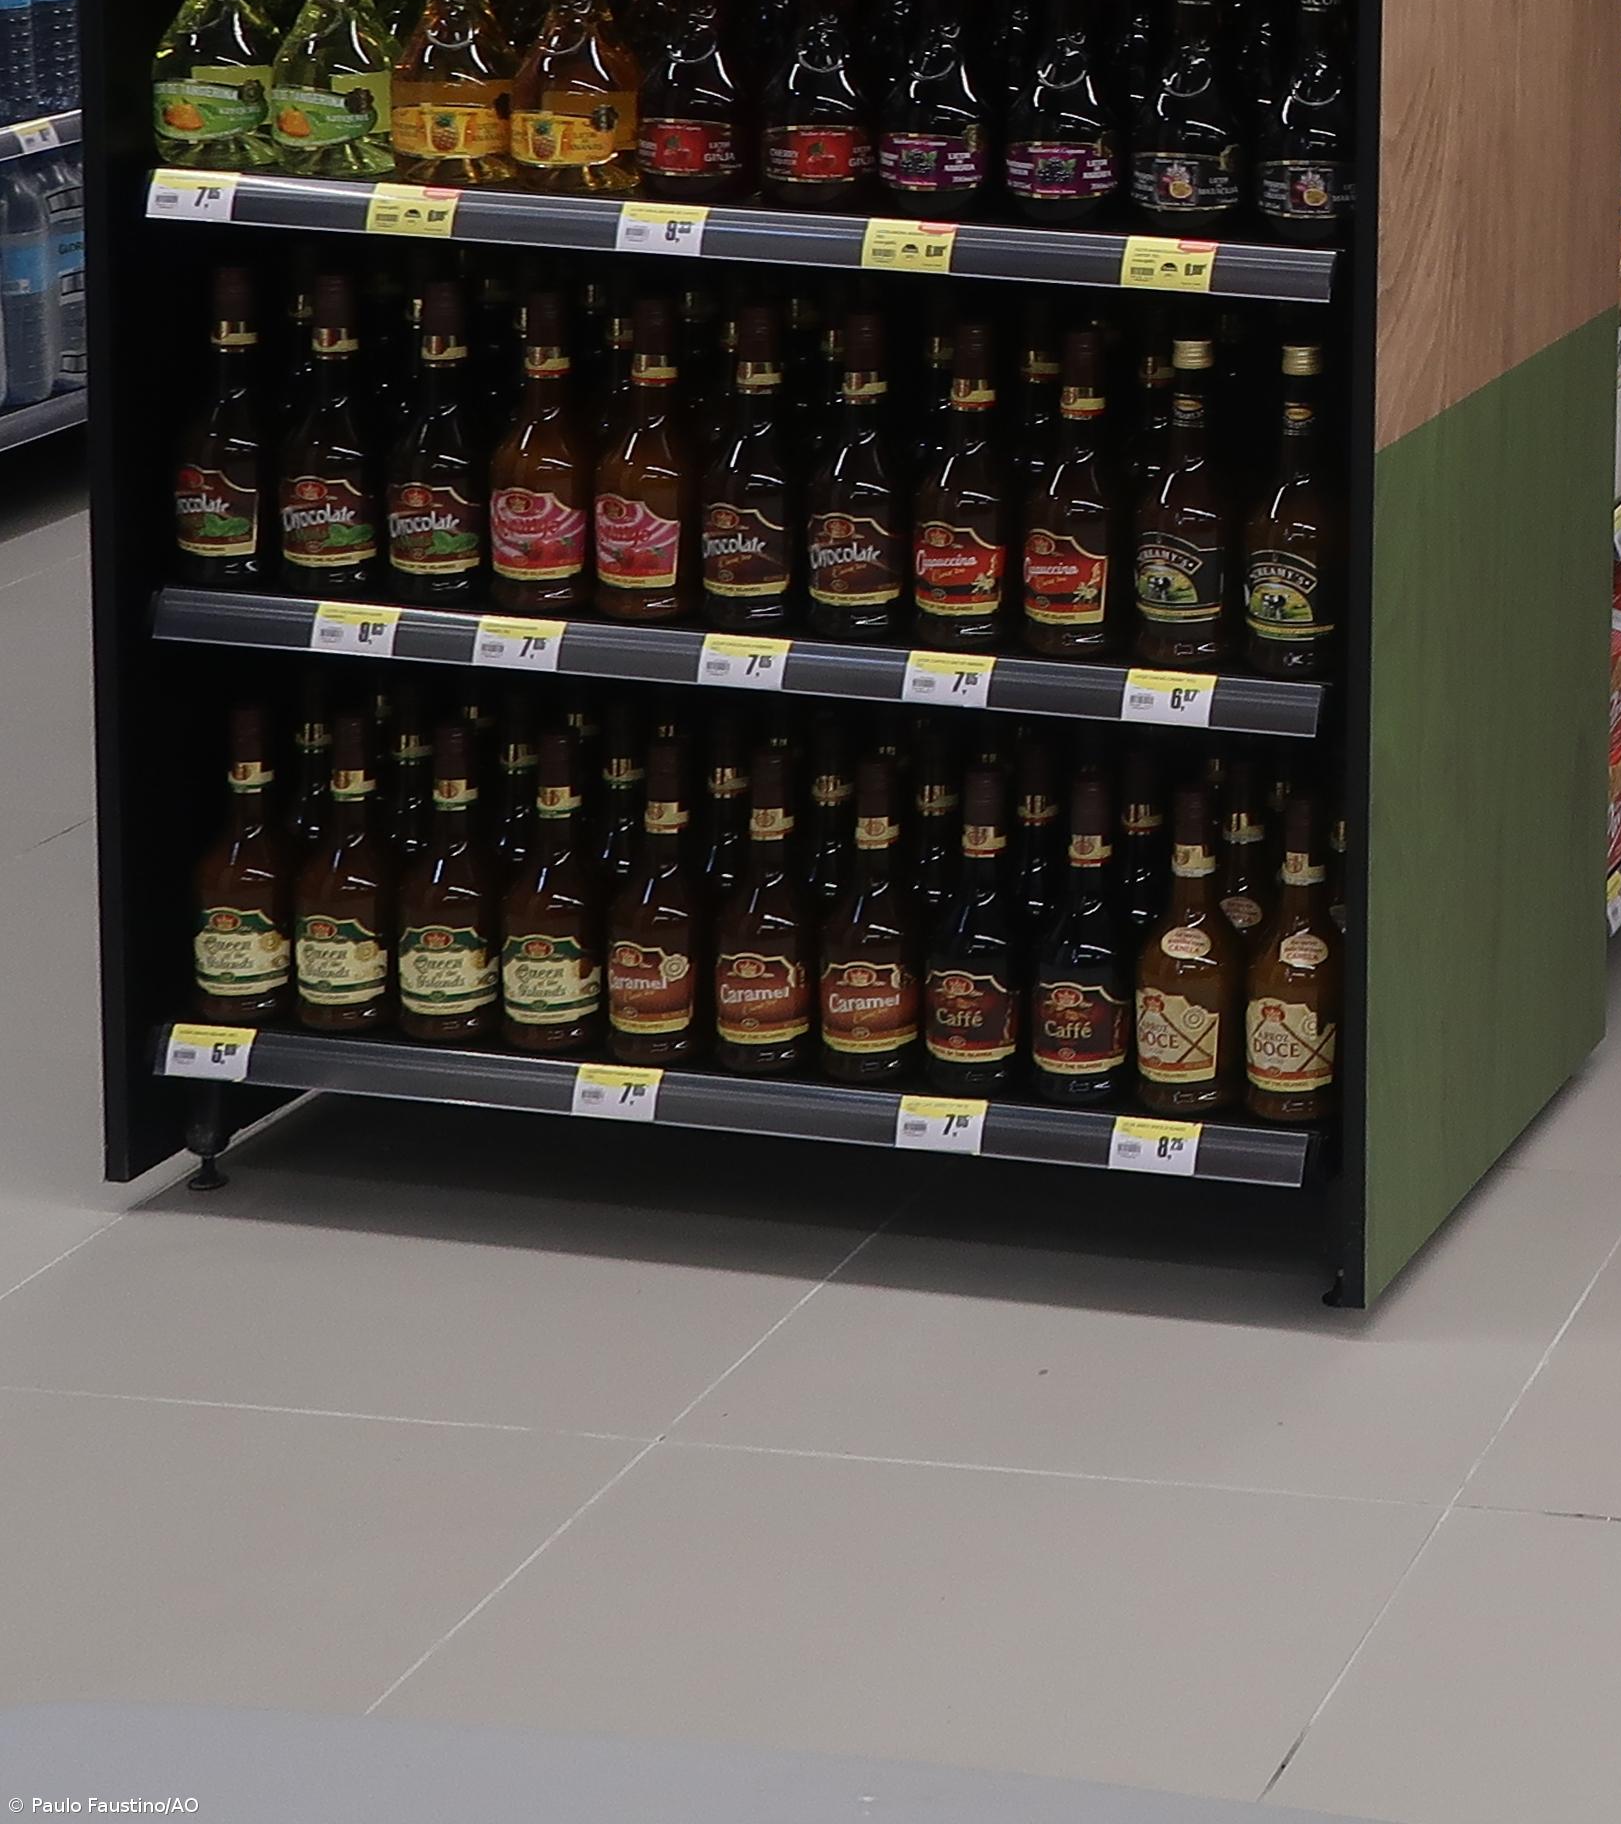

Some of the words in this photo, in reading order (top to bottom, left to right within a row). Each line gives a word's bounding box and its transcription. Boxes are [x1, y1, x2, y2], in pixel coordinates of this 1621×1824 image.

[283, 504, 356, 532] Chocolate
[390, 513, 459, 533] Chocolate
[413, 954, 463, 973] Queen
[720, 986, 790, 1005] Caramel
[829, 993, 899, 1014] Caramel
[937, 1007, 983, 1028] Caffé
[1045, 1019, 1092, 1040] Caffé
[1254, 1039, 1301, 1059] DOCE
